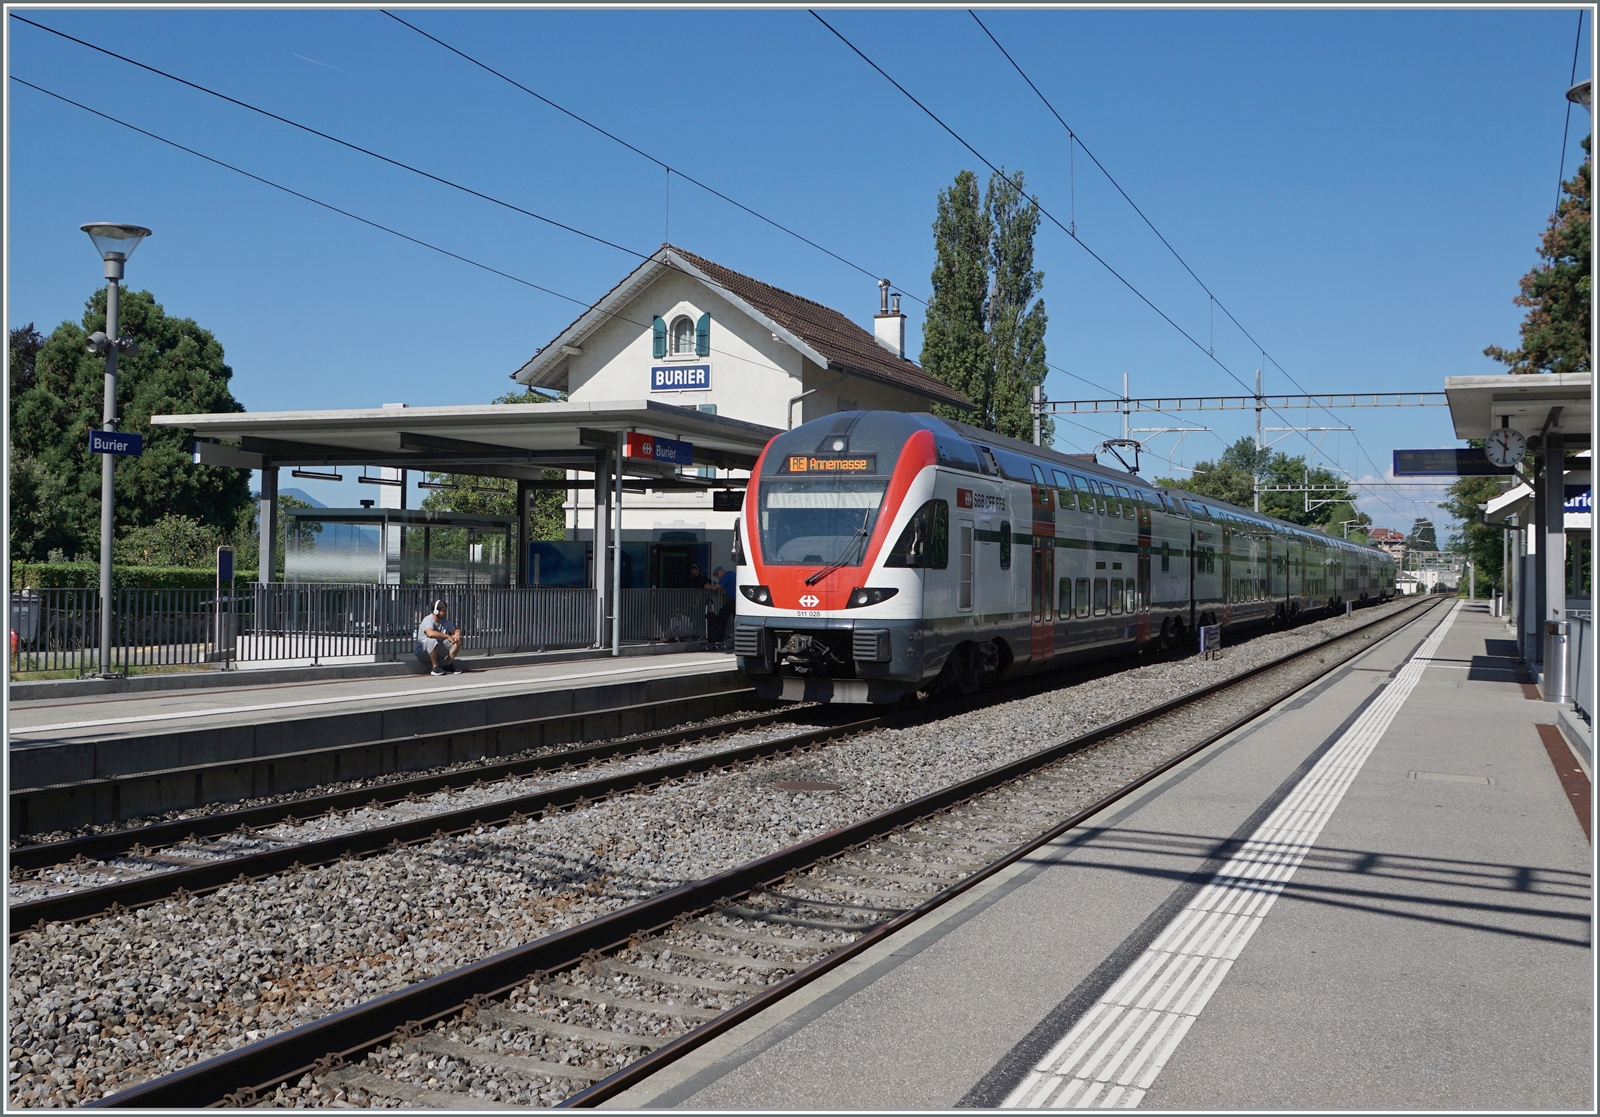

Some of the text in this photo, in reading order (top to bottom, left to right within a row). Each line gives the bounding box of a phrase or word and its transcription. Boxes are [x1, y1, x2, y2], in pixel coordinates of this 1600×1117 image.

[655, 368, 706, 386] BURIER
[93, 437, 129, 451] Burier
[656, 444, 677, 459] Burier
[791, 457, 867, 471] RE Annemasse
[973, 493, 1006, 512] SBB CFF FFS
[808, 610, 821, 618] 028
